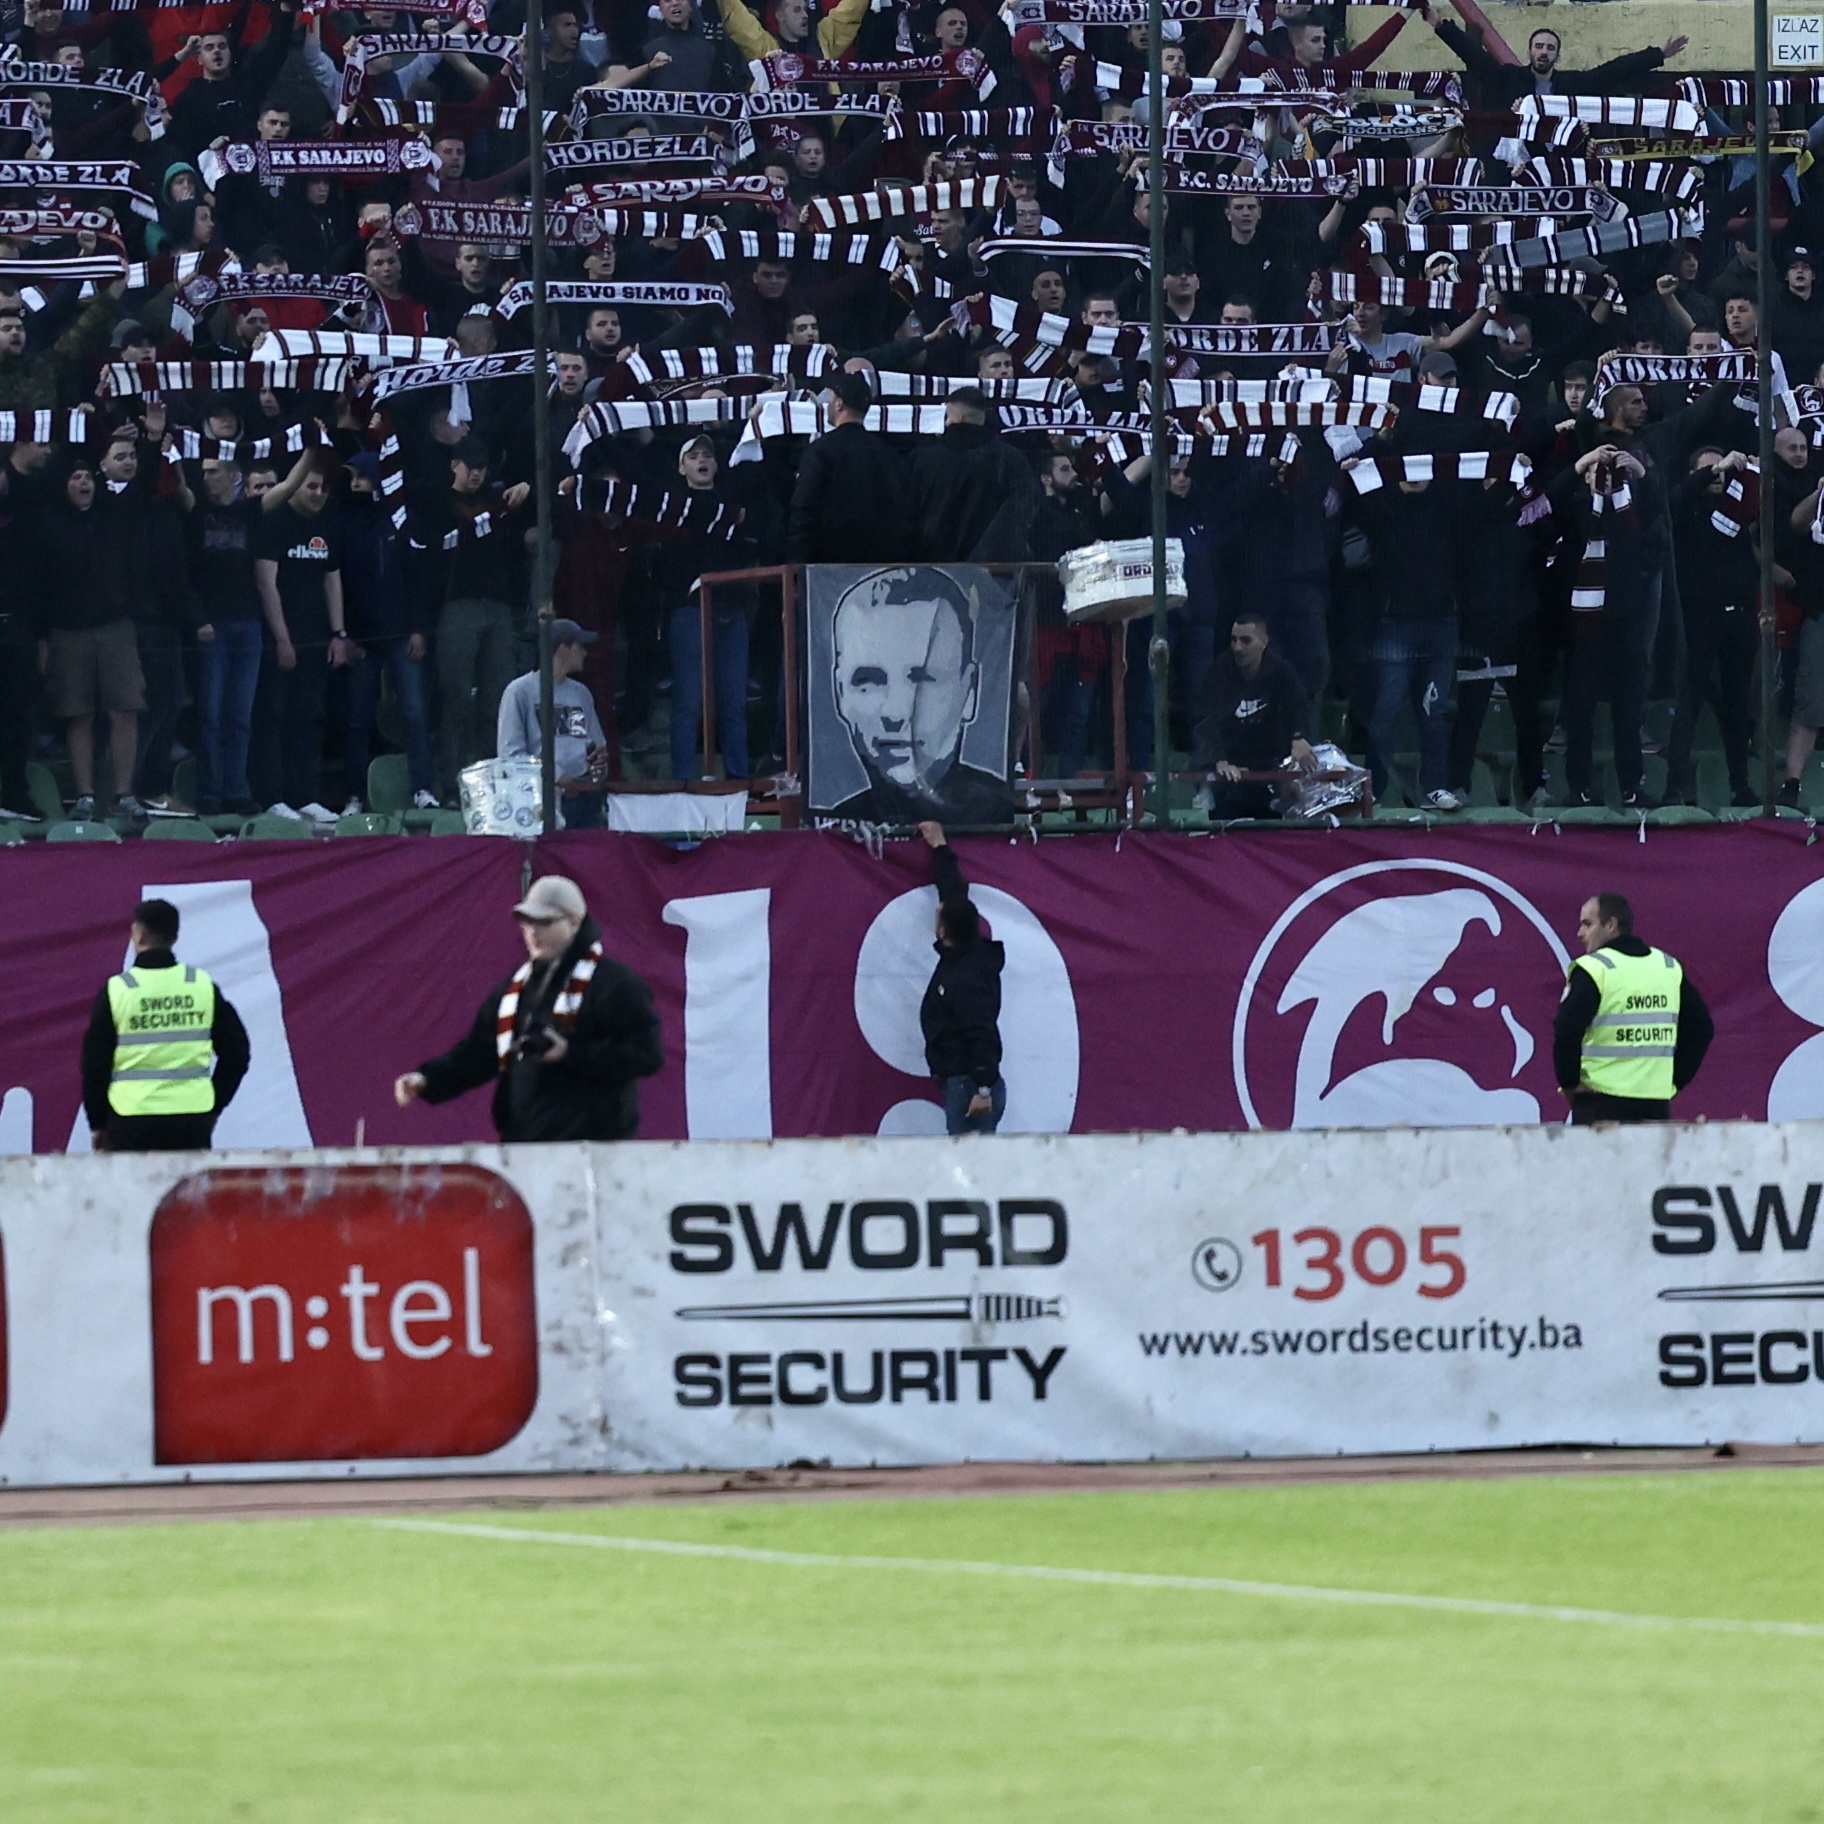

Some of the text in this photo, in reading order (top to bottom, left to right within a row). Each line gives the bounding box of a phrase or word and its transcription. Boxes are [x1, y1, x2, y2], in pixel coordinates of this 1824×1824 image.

[1777, 18, 1819, 33] IZLAZ
[360, 33, 511, 54] SARAJEVO
[1778, 44, 1818, 61] EXIT
[847, 54, 943, 72] SARAJEVO
[94, 69, 145, 94] ZLA
[605, 89, 733, 115] SARAJEVO
[299, 145, 385, 164] SARAJEVO
[80, 163, 133, 183] ZLA
[590, 176, 766, 202] SARAJEVO
[1214, 176, 1314, 194] SARAJEVO
[1450, 188, 1574, 213] SARAJEVO
[250, 275, 371, 299] SARAJEV
[619, 285, 685, 302] SIAMO
[140, 994, 194, 1012] SWORD
[1626, 994, 1668, 1010] SWORD
[129, 1009, 206, 1030] SECURITY
[1616, 1026, 1674, 1043] SECURITY
[669, 1198, 1069, 1274] SWORD
[1250, 1224, 1467, 1302] 1305
[196, 1247, 493, 1365] m:tel
[1138, 1316, 1584, 1359] www.swordsecurity.ba
[674, 1346, 1067, 1409] SECURITY
